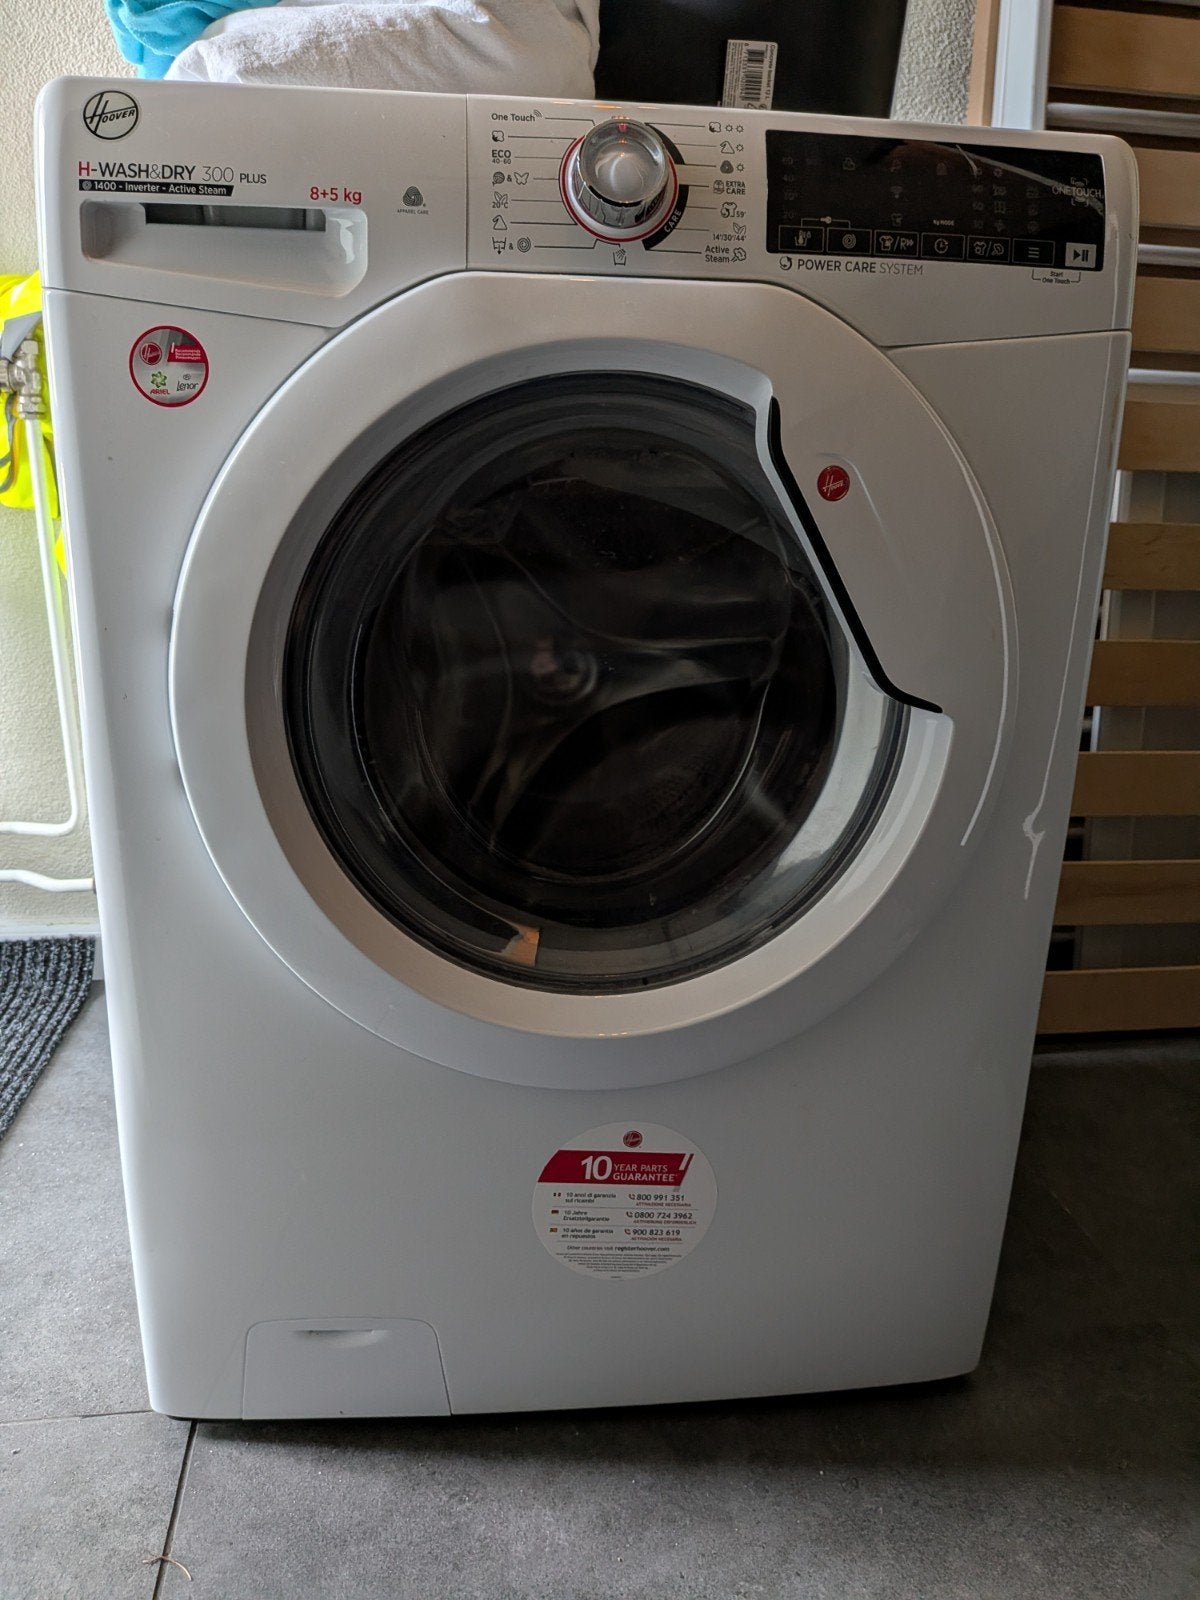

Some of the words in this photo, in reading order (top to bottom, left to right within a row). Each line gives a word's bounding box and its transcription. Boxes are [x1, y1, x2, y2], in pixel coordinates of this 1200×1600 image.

[511, 113, 535, 122] Touch
[492, 150, 511, 158] ECO
[78, 162, 196, 181] H-WASH&DRY
[202, 166, 234, 182] 300
[240, 172, 266, 184] PLUS
[95, 181, 117, 192] 1400
[125, 182, 161, 193] Inverter
[168, 184, 197, 195] Active
[198, 186, 227, 196] Steam
[310, 187, 339, 201] 8+5
[343, 187, 362, 205] kg
[1052, 183, 1102, 198] ONETOUCH
[664, 209, 682, 233] CARE
[705, 245, 729, 253] Active
[798, 259, 841, 272] POWER
[845, 261, 876, 274] CARE
[880, 263, 924, 276] SYSTEM
[176, 381, 198, 391] Lenor
[581, 1155, 612, 1180] 10
[614, 1164, 637, 1172] YEAR
